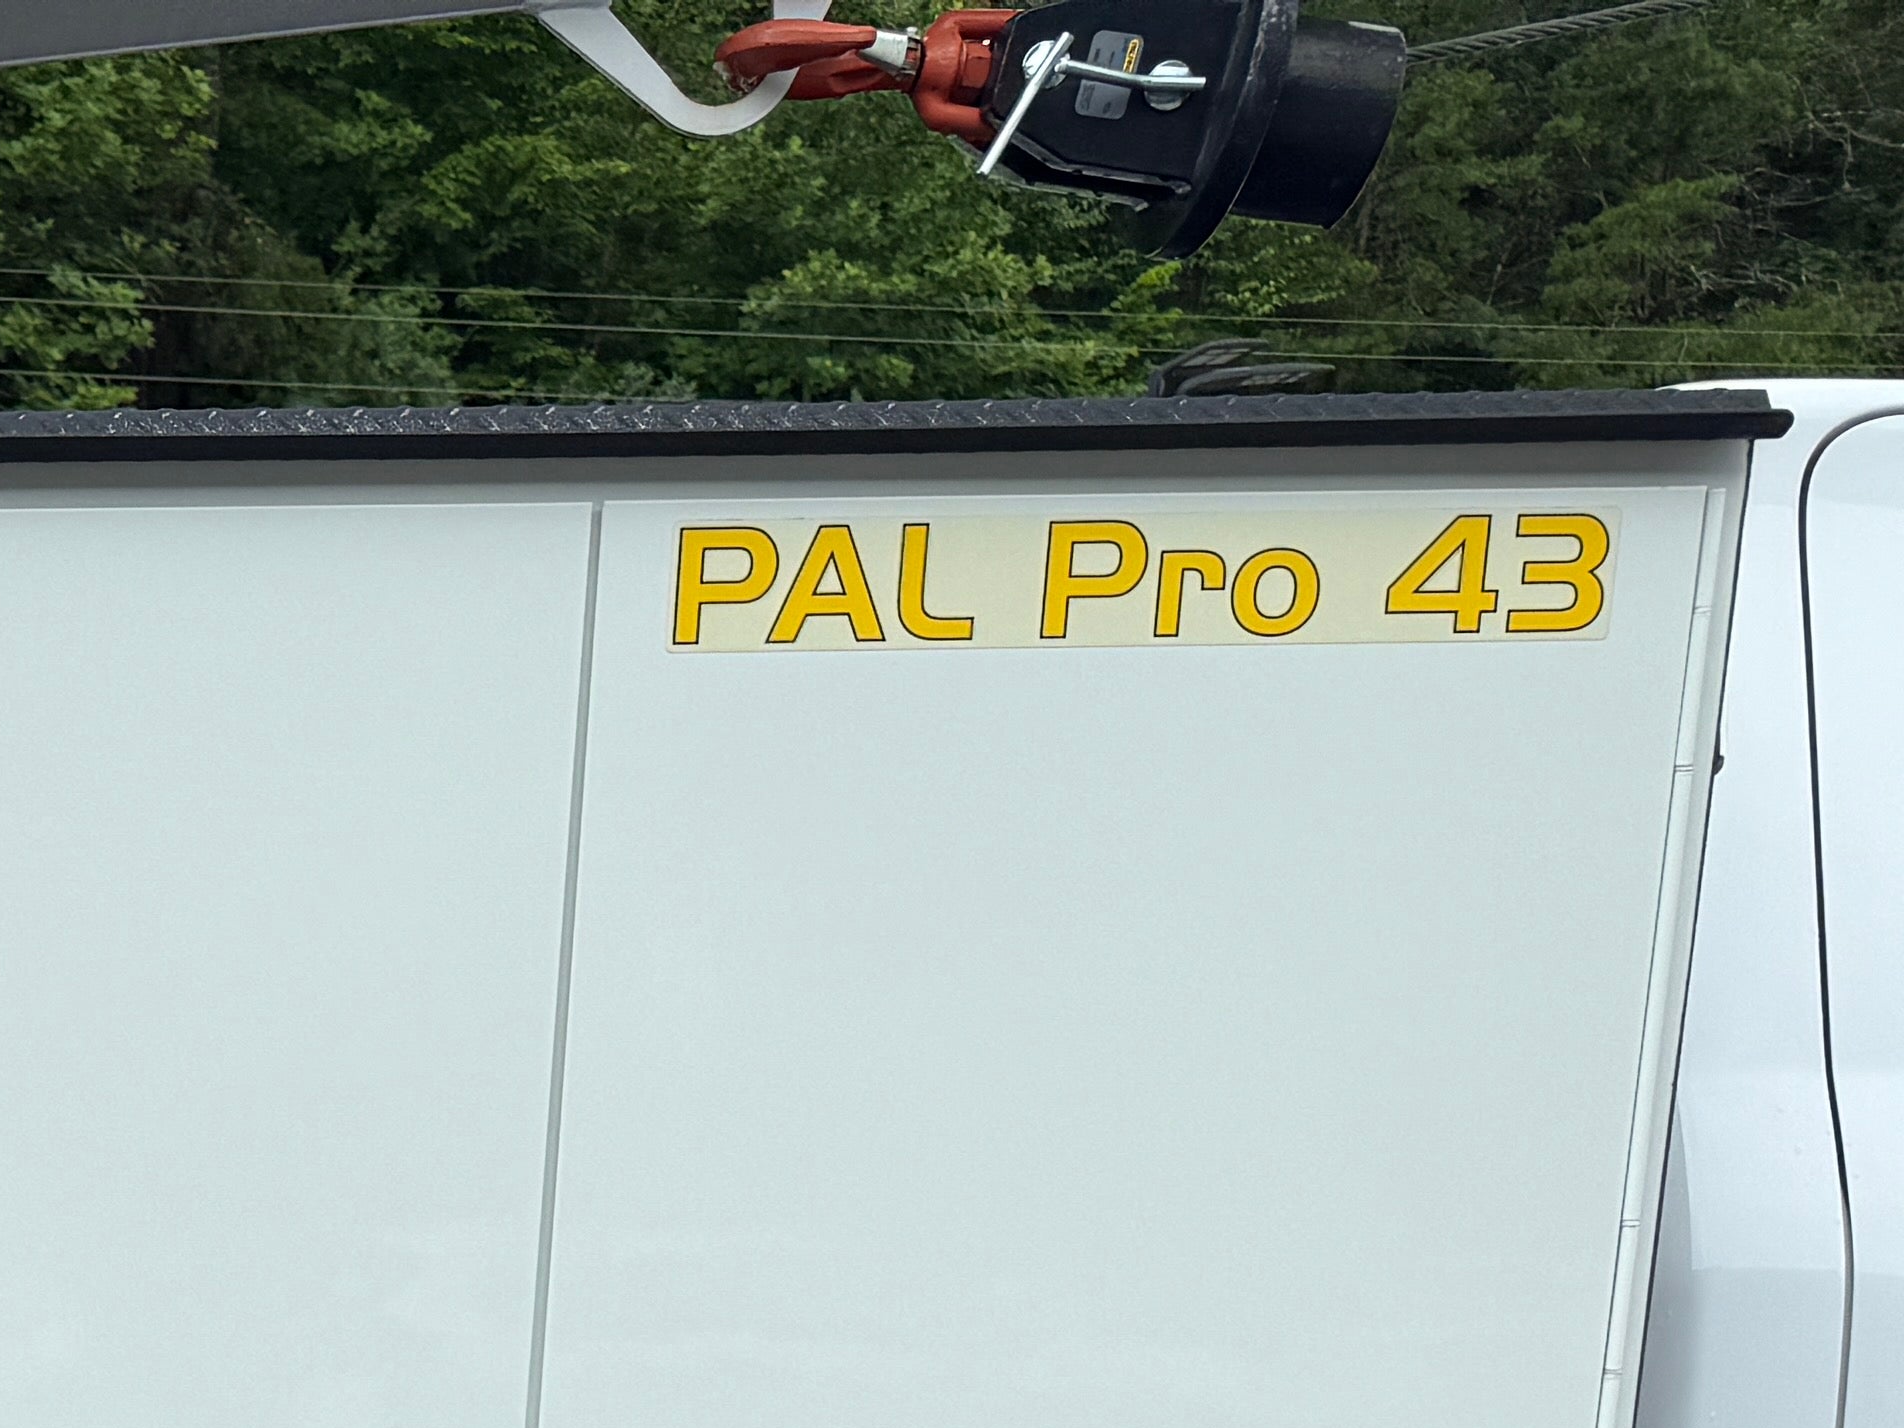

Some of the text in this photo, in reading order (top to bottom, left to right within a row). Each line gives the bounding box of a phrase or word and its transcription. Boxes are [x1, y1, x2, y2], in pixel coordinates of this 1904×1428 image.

[672, 513, 1611, 645] PAL Pro 43
